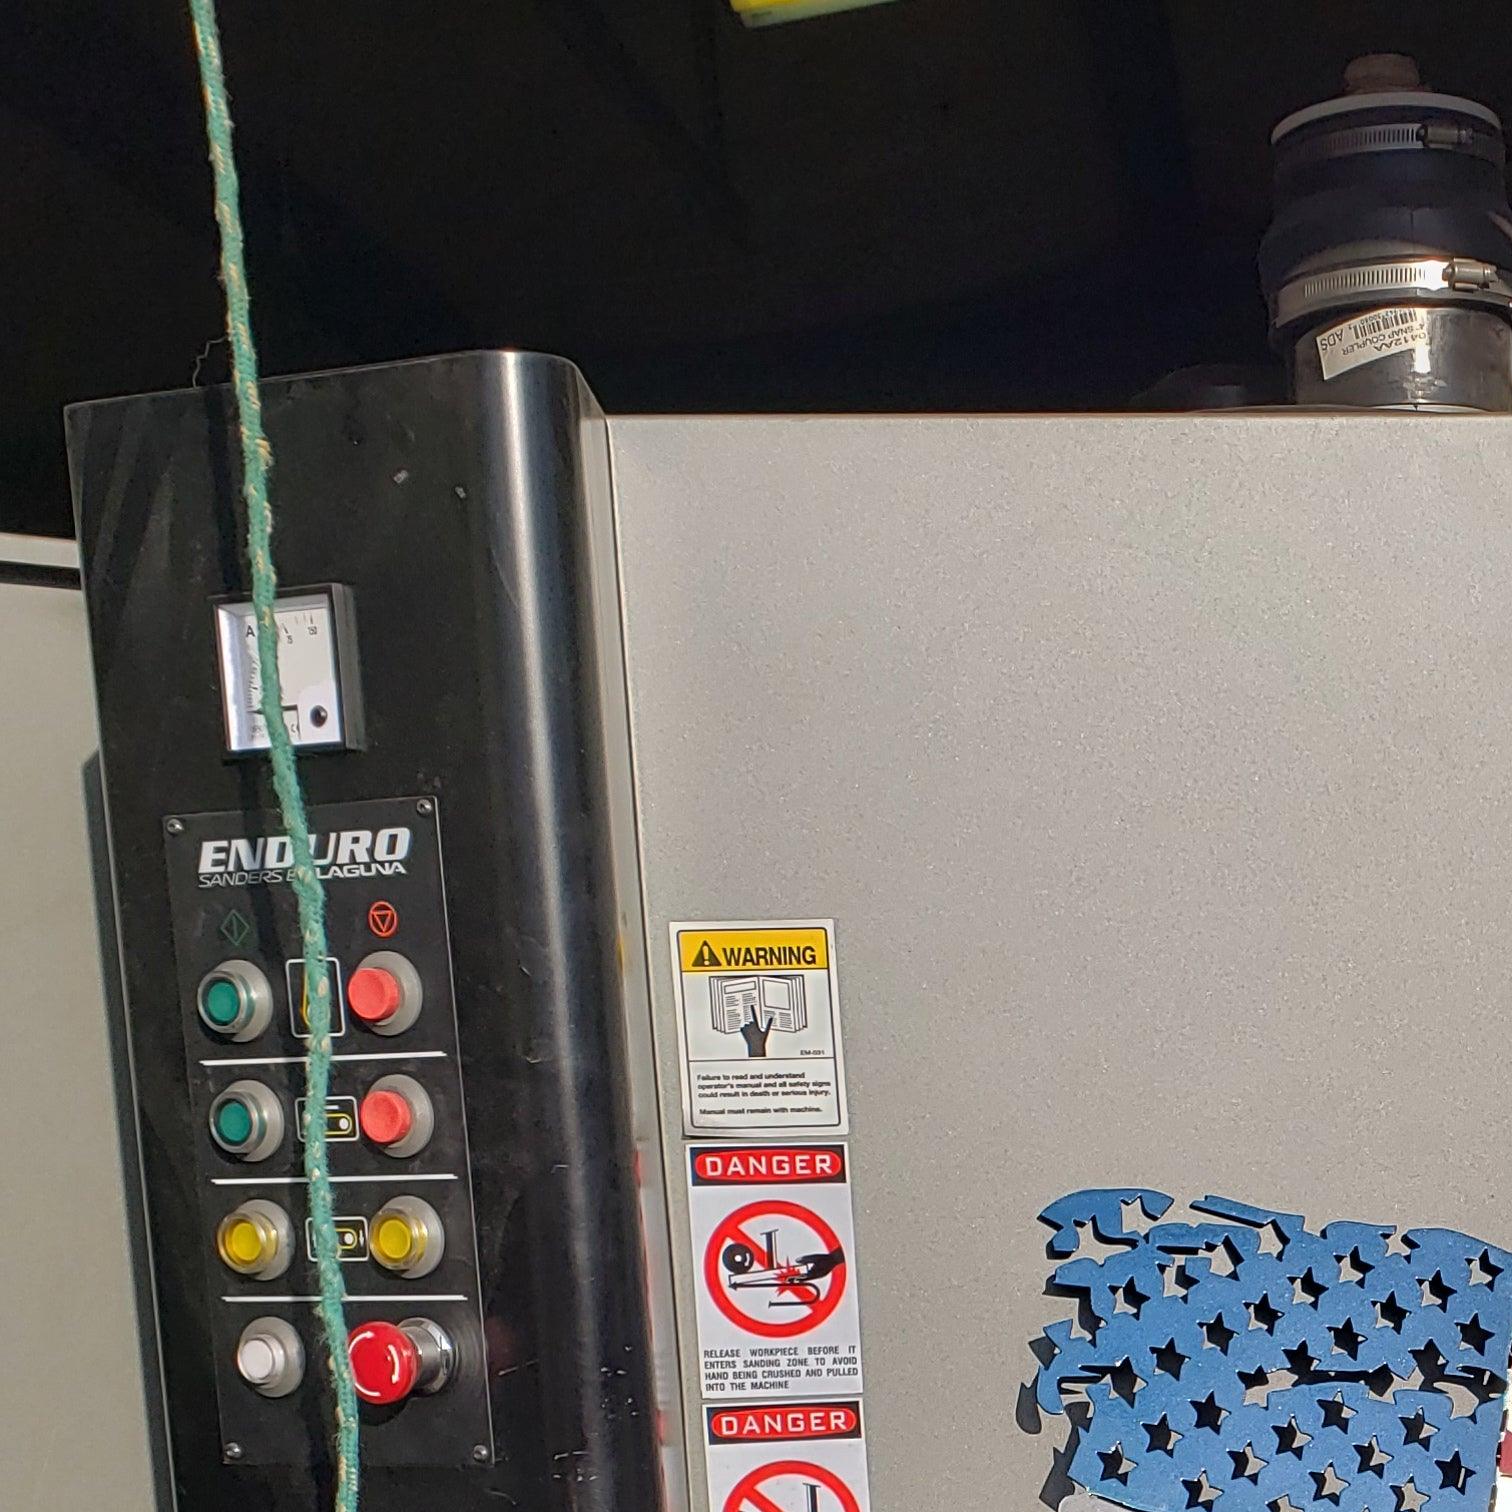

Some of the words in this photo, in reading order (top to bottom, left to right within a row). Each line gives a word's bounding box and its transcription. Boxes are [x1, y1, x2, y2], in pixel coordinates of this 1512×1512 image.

[1321, 329, 1344, 351] ADS
[1388, 326, 1413, 339] SNAP
[1343, 335, 1385, 355] COUPLER
[246, 625, 255, 637] A
[198, 827, 411, 874] ENDURO
[198, 870, 283, 888] SANDERS
[315, 862, 407, 879] LAGUNA
[722, 946, 816, 966] WARNING
[705, 1155, 832, 1176] DANGER
[704, 1349, 741, 1358] RELEASE
[750, 1347, 798, 1357] WORKPIECE
[808, 1346, 839, 1354] BEFORE
[848, 1345, 856, 1354] IT
[705, 1360, 736, 1369] ENTERS
[743, 1359, 780, 1367] SANDING
[787, 1358, 808, 1366] ZONE
[815, 1357, 825, 1366] TO
[832, 1357, 857, 1365] AVOID
[705, 1371, 728, 1380] HAND
[733, 1370, 757, 1379] BEING
[762, 1369, 801, 1378] CRUSHED
[805, 1369, 822, 1377] AND
[827, 1368, 858, 1377] PULLED
[706, 1382, 725, 1391] INTO
[730, 1381, 746, 1390] THE
[751, 1381, 789, 1390] MACHINE
[721, 1411, 847, 1435] DANGER
